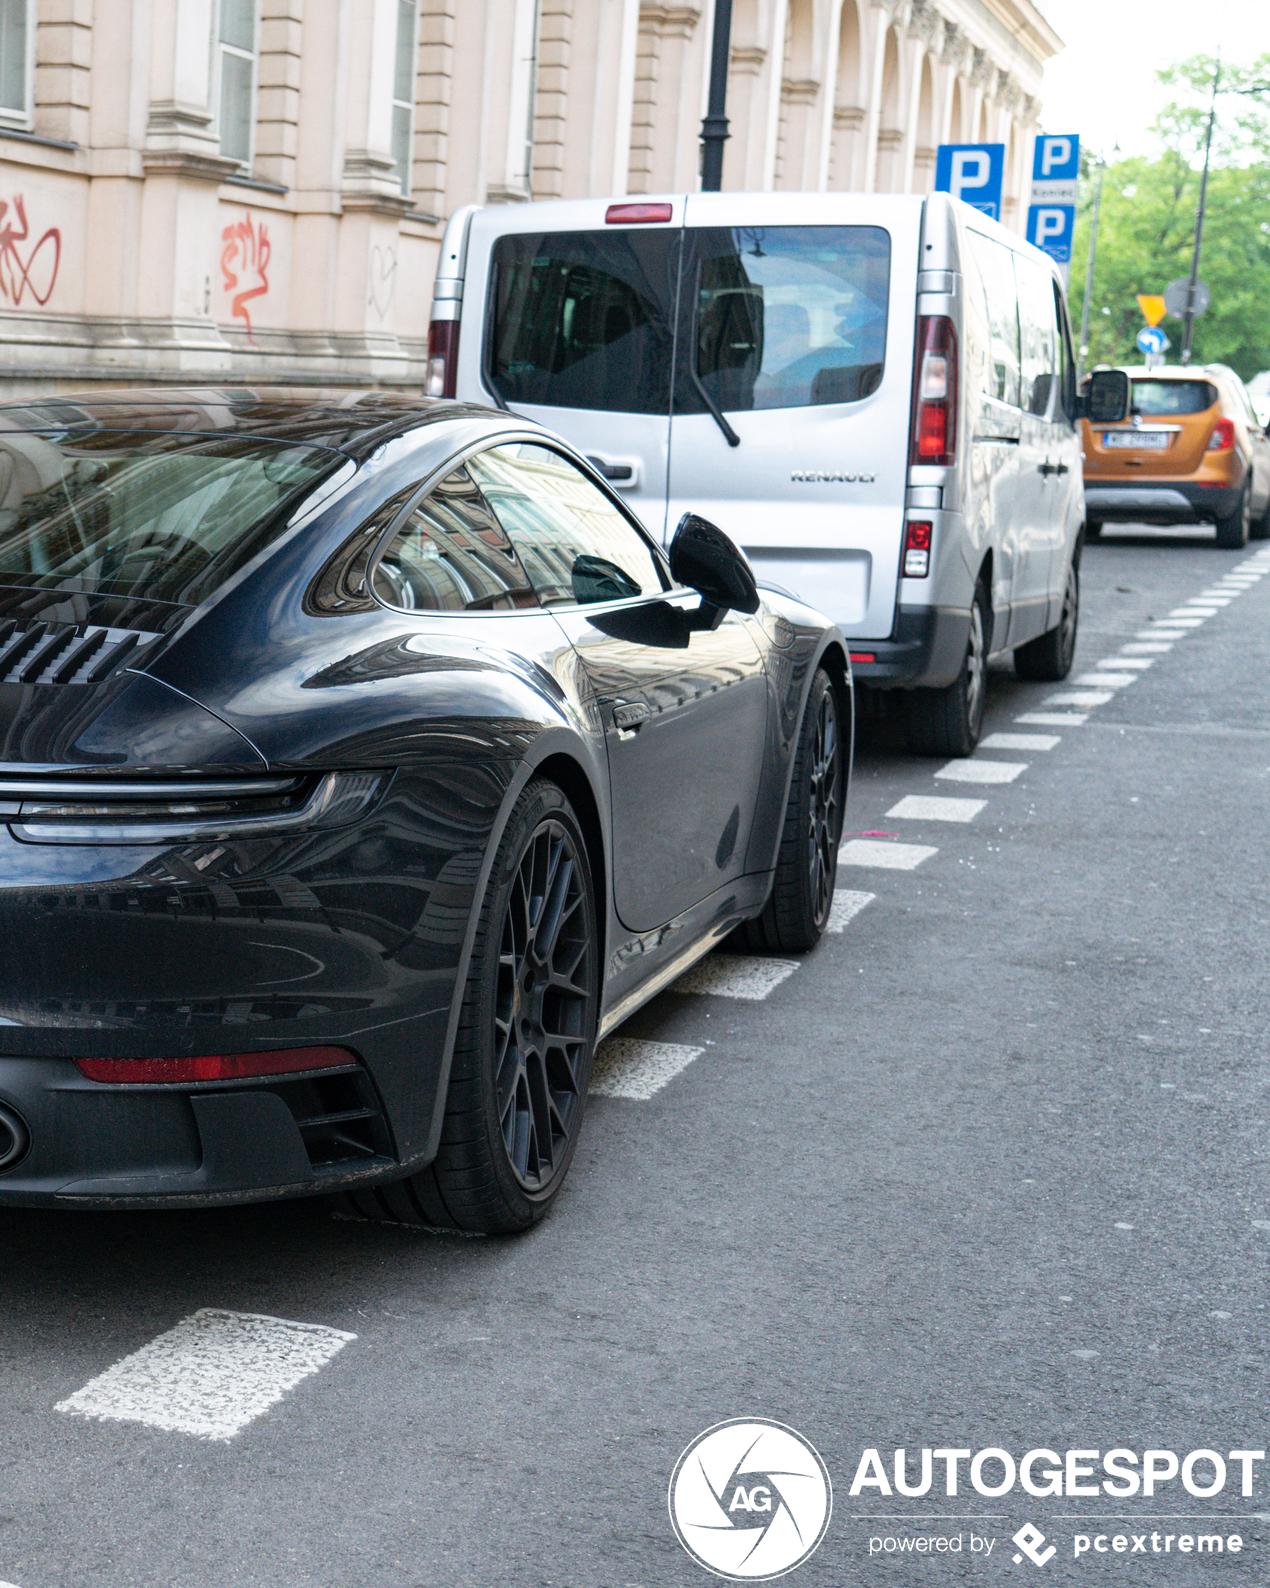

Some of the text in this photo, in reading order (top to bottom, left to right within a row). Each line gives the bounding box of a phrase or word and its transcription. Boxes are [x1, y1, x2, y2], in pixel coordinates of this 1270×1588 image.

[949, 150, 991, 199] P
[1042, 137, 1071, 175] P
[1035, 208, 1065, 246] P
[790, 470, 878, 483] RENAULT
